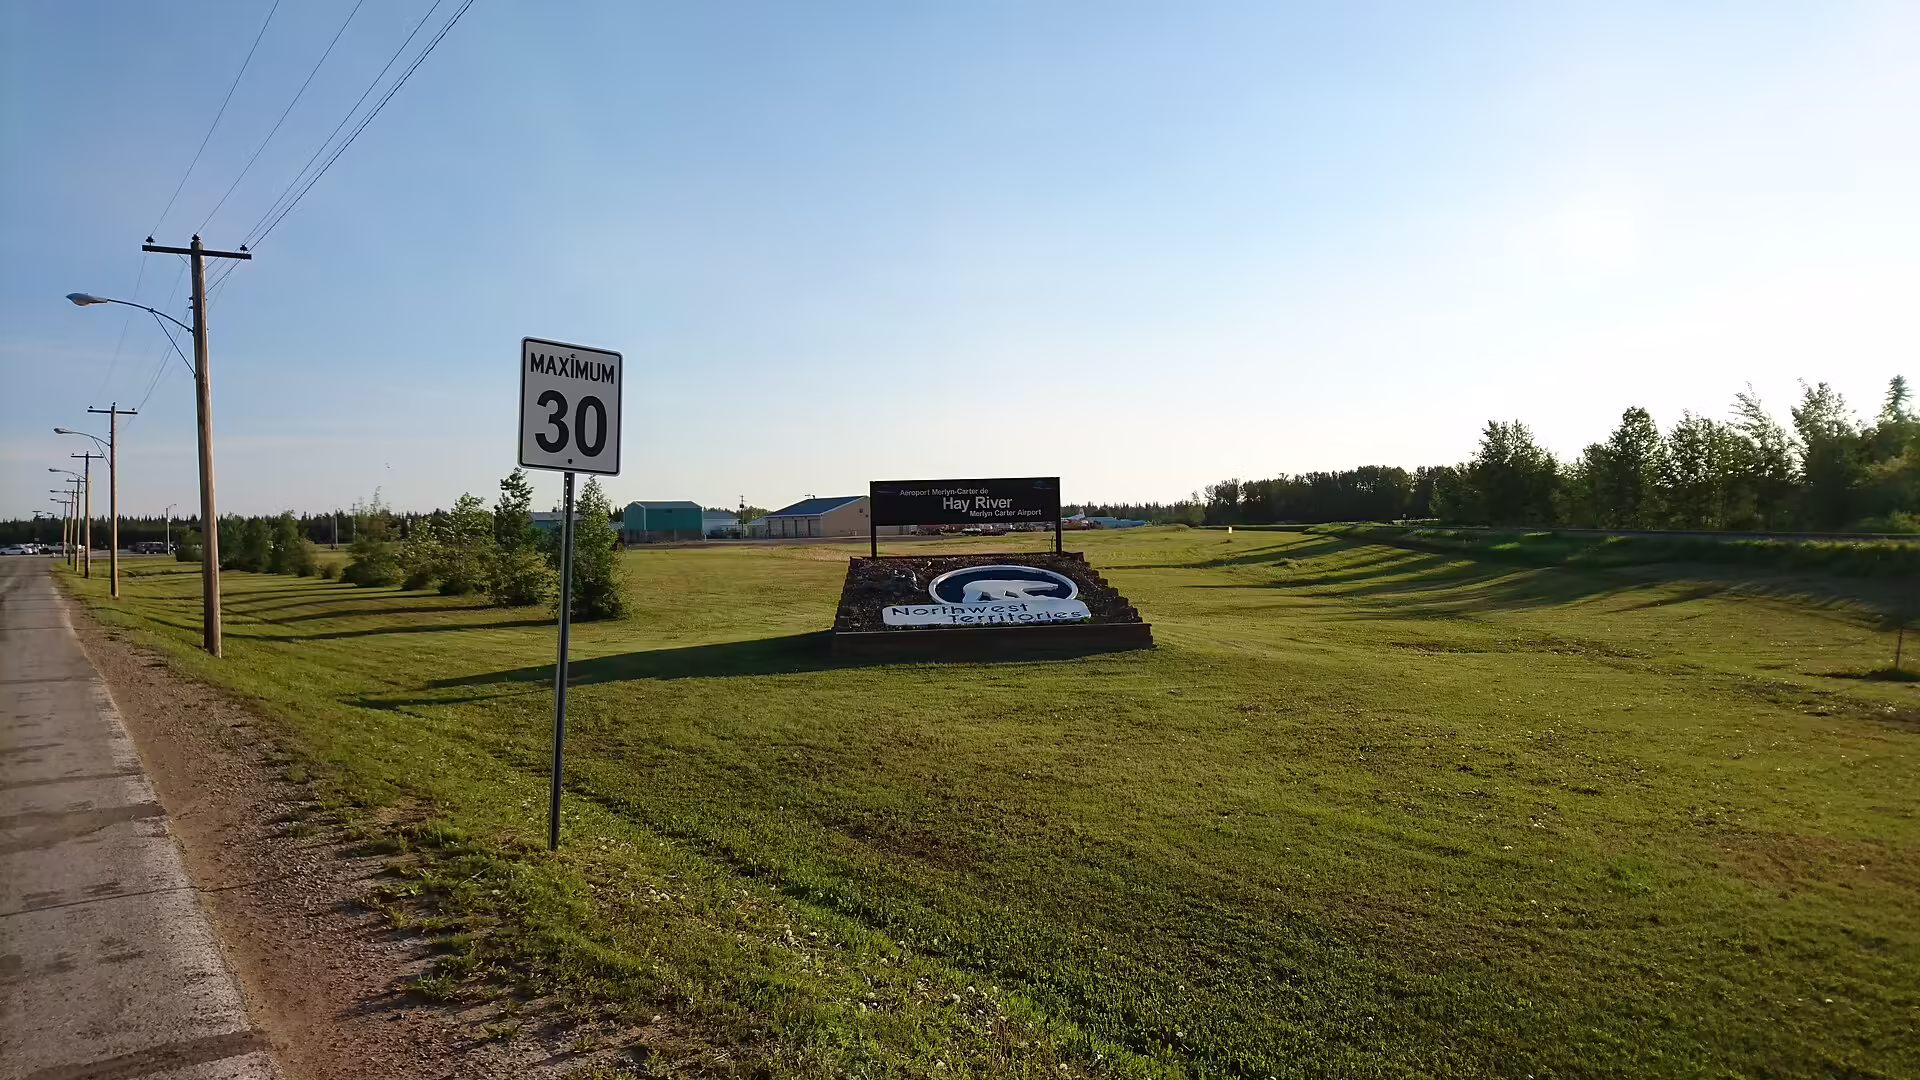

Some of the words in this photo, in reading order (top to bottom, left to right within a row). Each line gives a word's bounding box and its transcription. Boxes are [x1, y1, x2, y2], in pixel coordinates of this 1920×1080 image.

[530, 352, 615, 385] MAXIMUM
[535, 389, 607, 457] 30
[932, 488, 979, 496] Merlyn-Carter
[980, 487, 989, 495] de
[943, 497, 971, 513] Hay
[975, 496, 1012, 509] River
[969, 510, 993, 519] Merlyn
[994, 509, 1016, 517] Carter
[1017, 508, 1042, 517] Airport
[892, 603, 1028, 615] Northwest
[948, 611, 1082, 623] Territories
